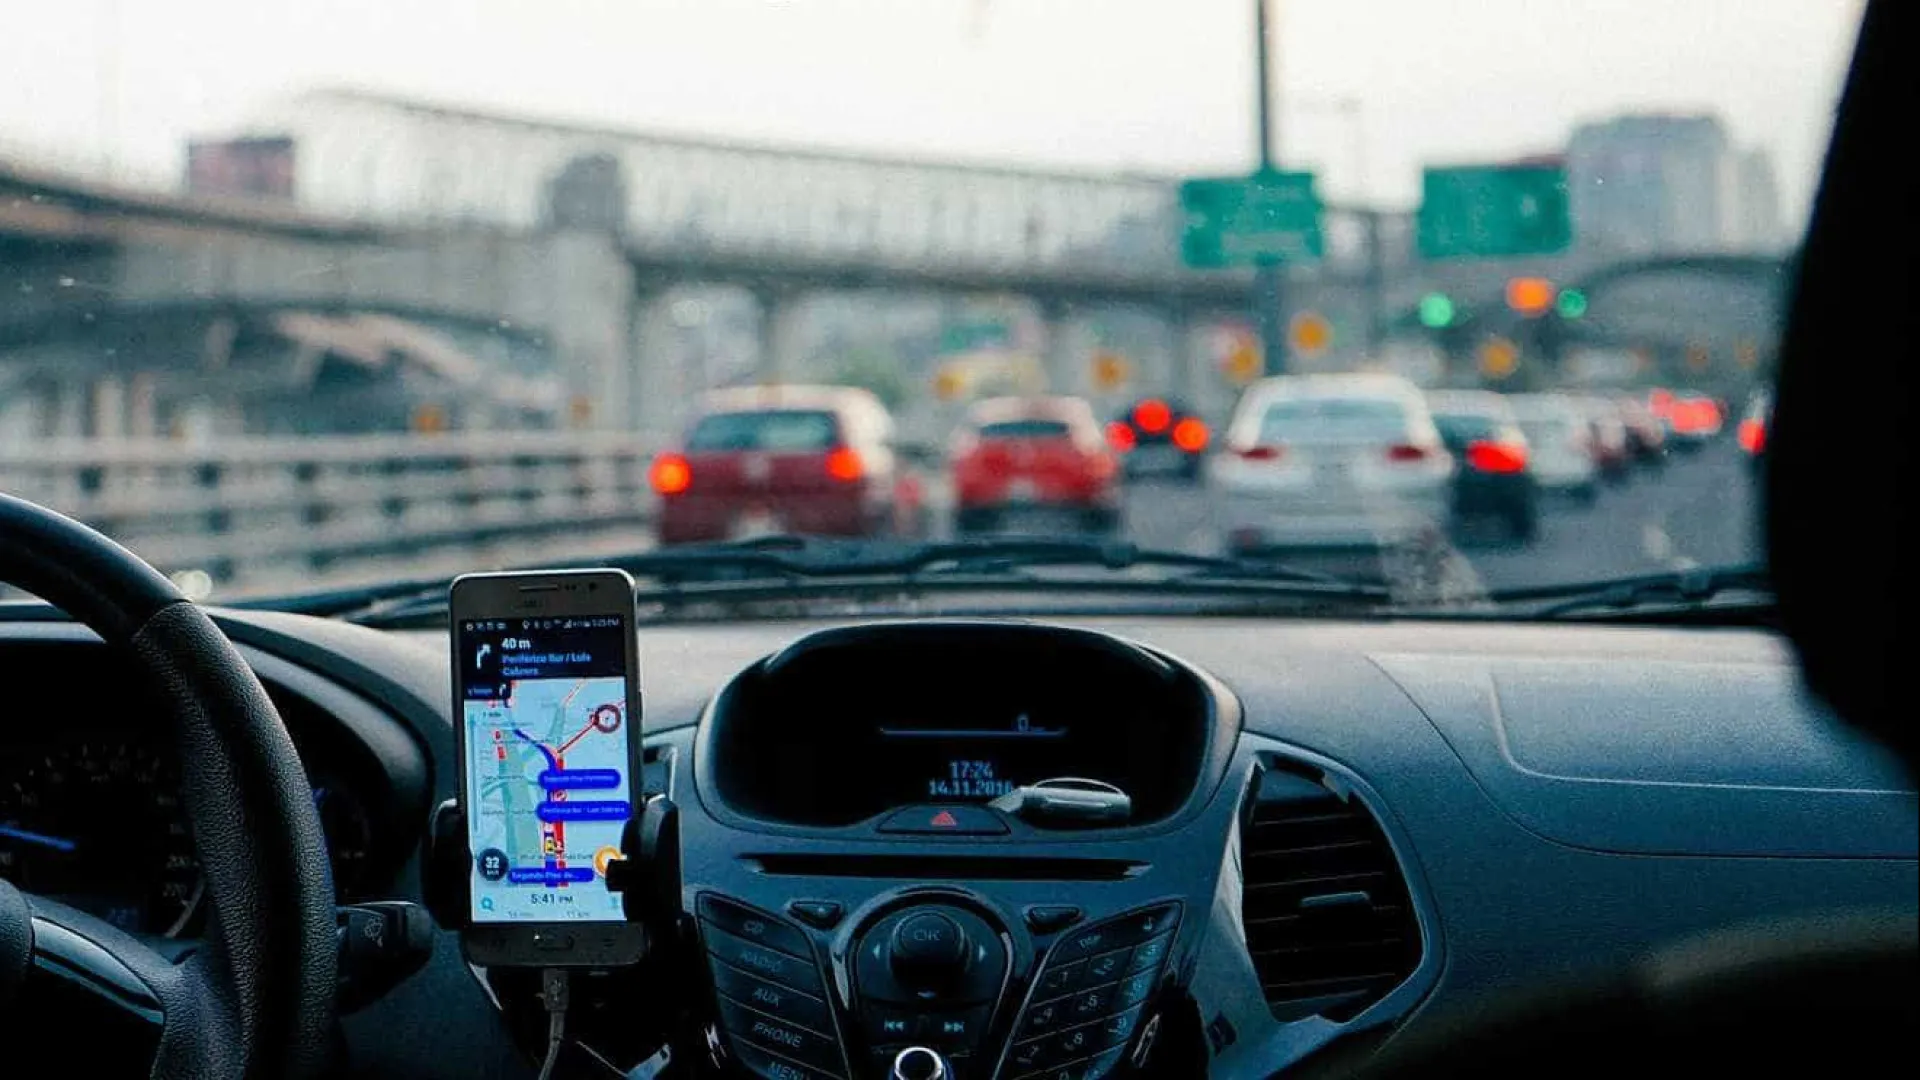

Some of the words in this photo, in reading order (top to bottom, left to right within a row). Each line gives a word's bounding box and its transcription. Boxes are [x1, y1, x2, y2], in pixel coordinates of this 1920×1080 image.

[502, 638, 517, 650] 40
[518, 639, 531, 650] m
[485, 856, 500, 868] 32
[530, 893, 555, 905] 5:41
[558, 896, 574, 904] PM
[914, 928, 941, 942] OK
[752, 1021, 803, 1048] PHONE
